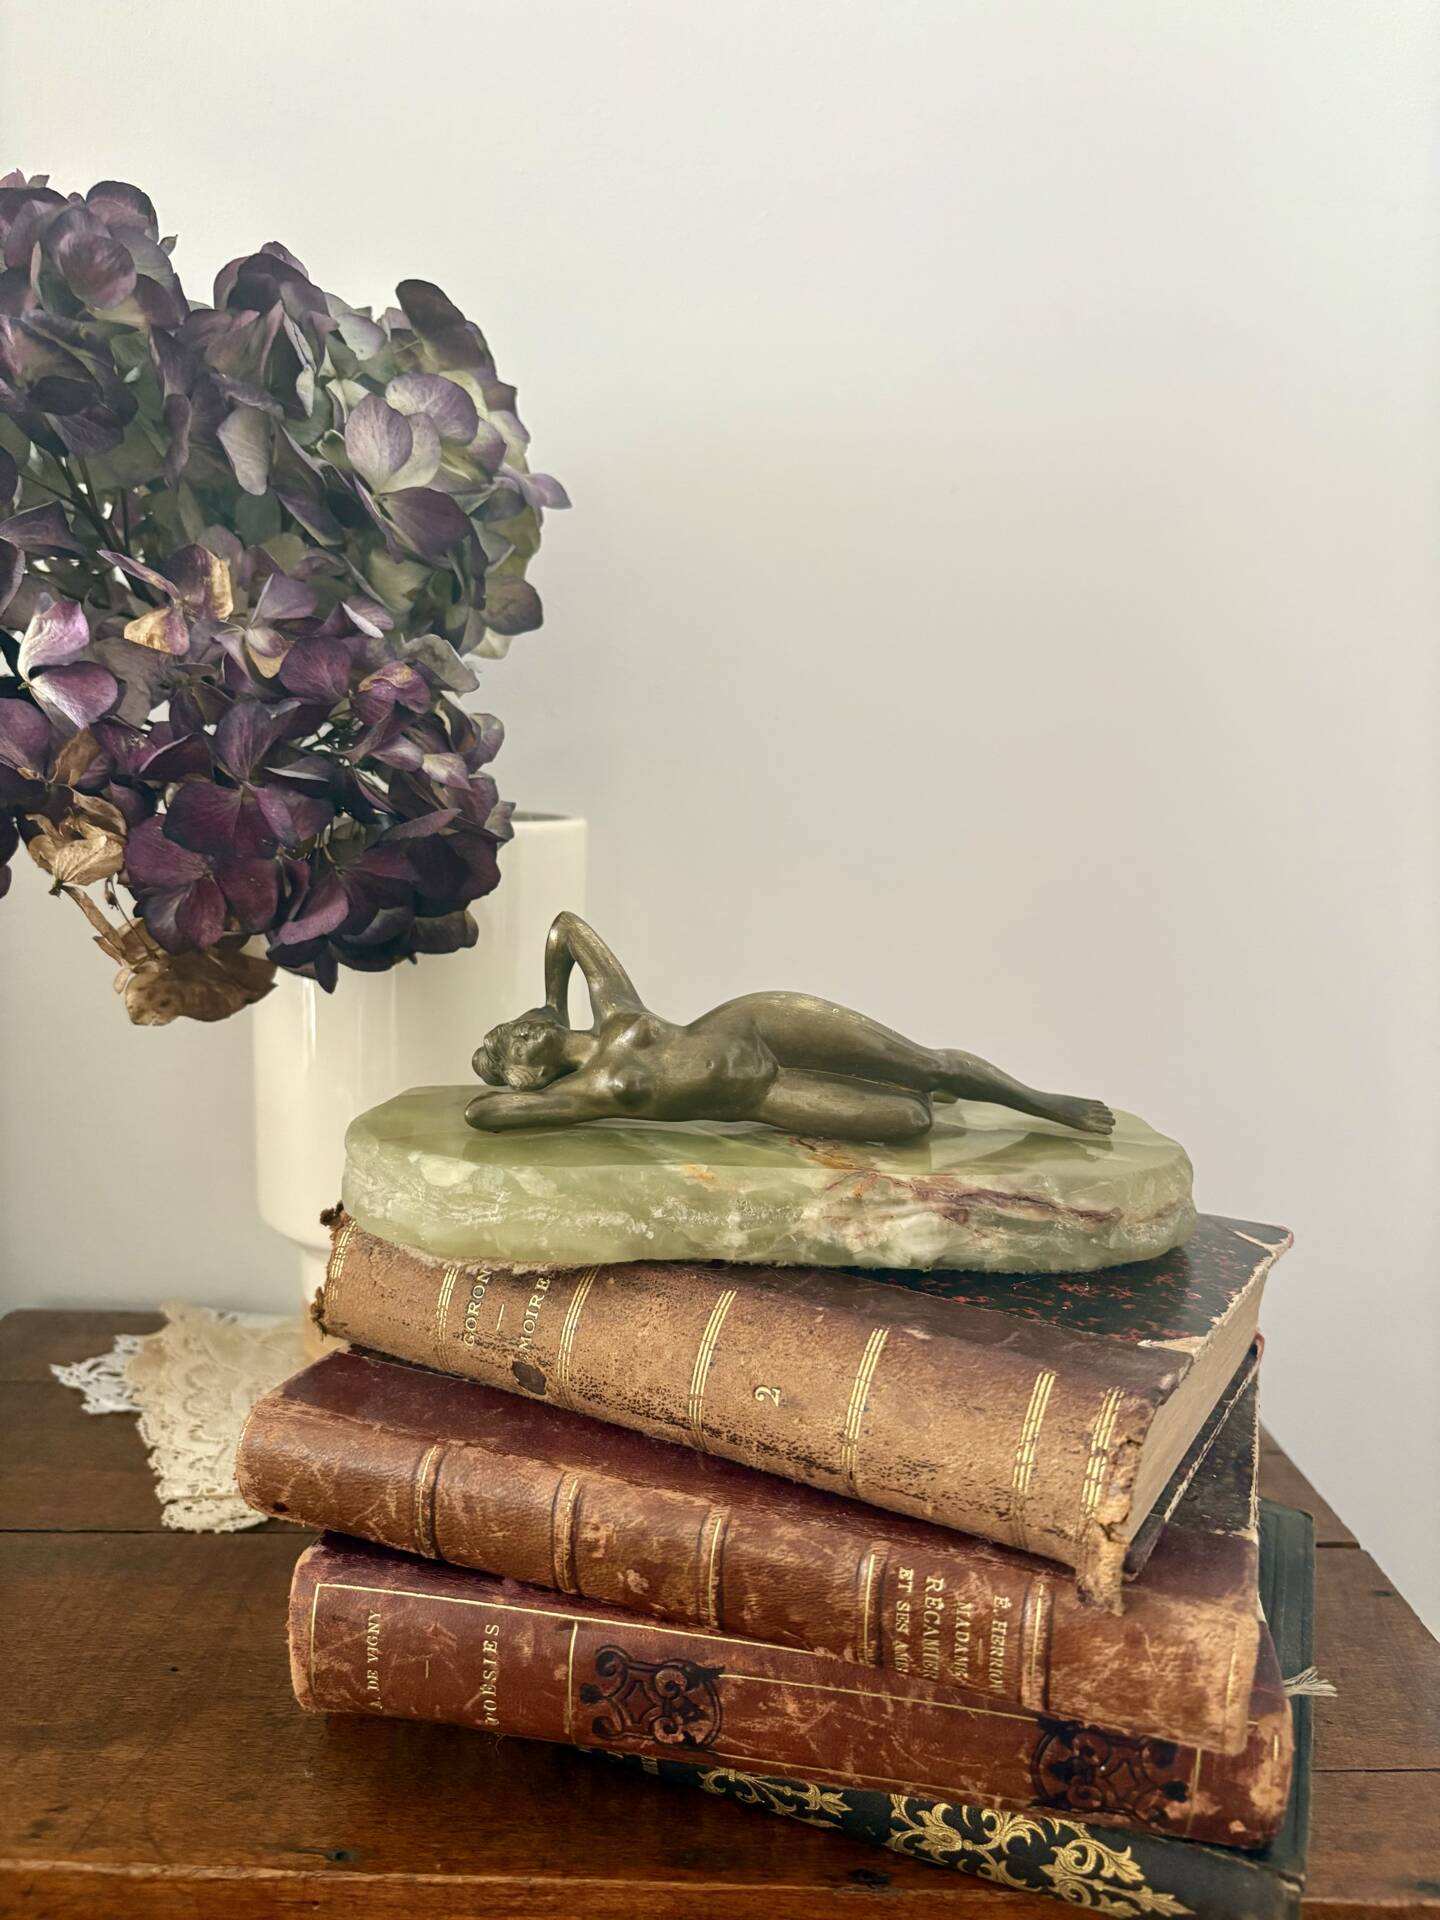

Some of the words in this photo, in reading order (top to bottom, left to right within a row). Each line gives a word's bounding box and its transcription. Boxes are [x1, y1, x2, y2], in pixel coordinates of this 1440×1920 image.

[463, 1270, 492, 1347] GORON
[519, 1277, 551, 1361] MOIRE
[754, 1386, 781, 1408] 2
[898, 1567, 914, 1592] ET
[366, 1609, 382, 1663] VIGNY
[896, 1601, 910, 1635] SES
[922, 1576, 945, 1679] RÉCAMIER
[366, 1669, 380, 1691] DE
